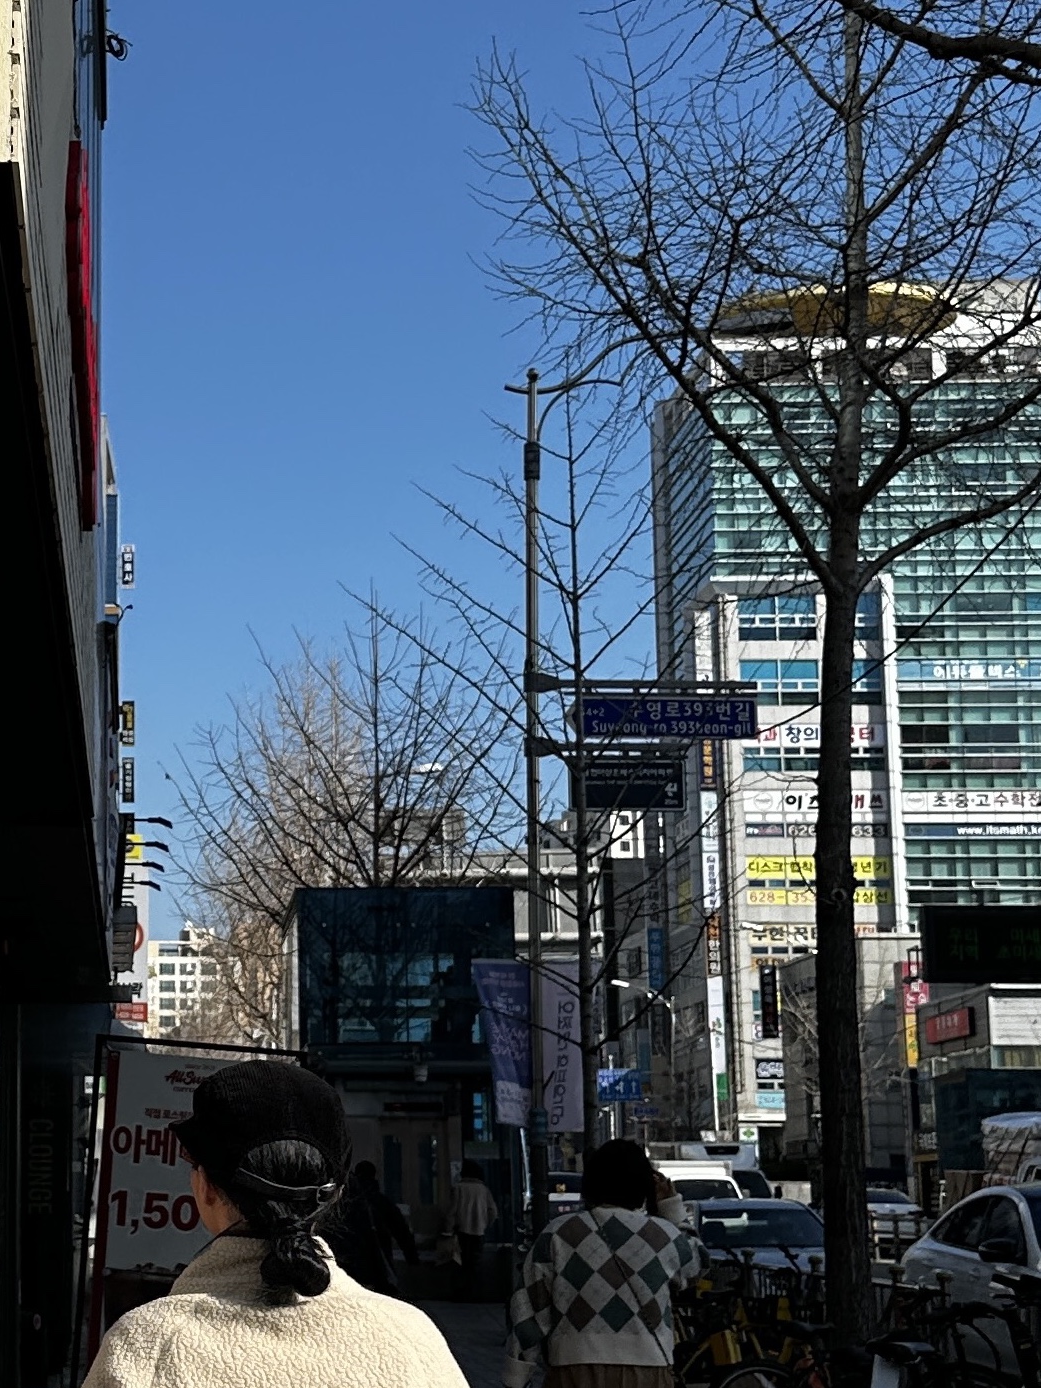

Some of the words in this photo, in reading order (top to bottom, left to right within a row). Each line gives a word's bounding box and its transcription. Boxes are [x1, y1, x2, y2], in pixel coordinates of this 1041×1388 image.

[786, 726, 819, 743] 창의
[748, 861, 784, 873] 디스크
[112, 1124, 190, 1167] 아메
